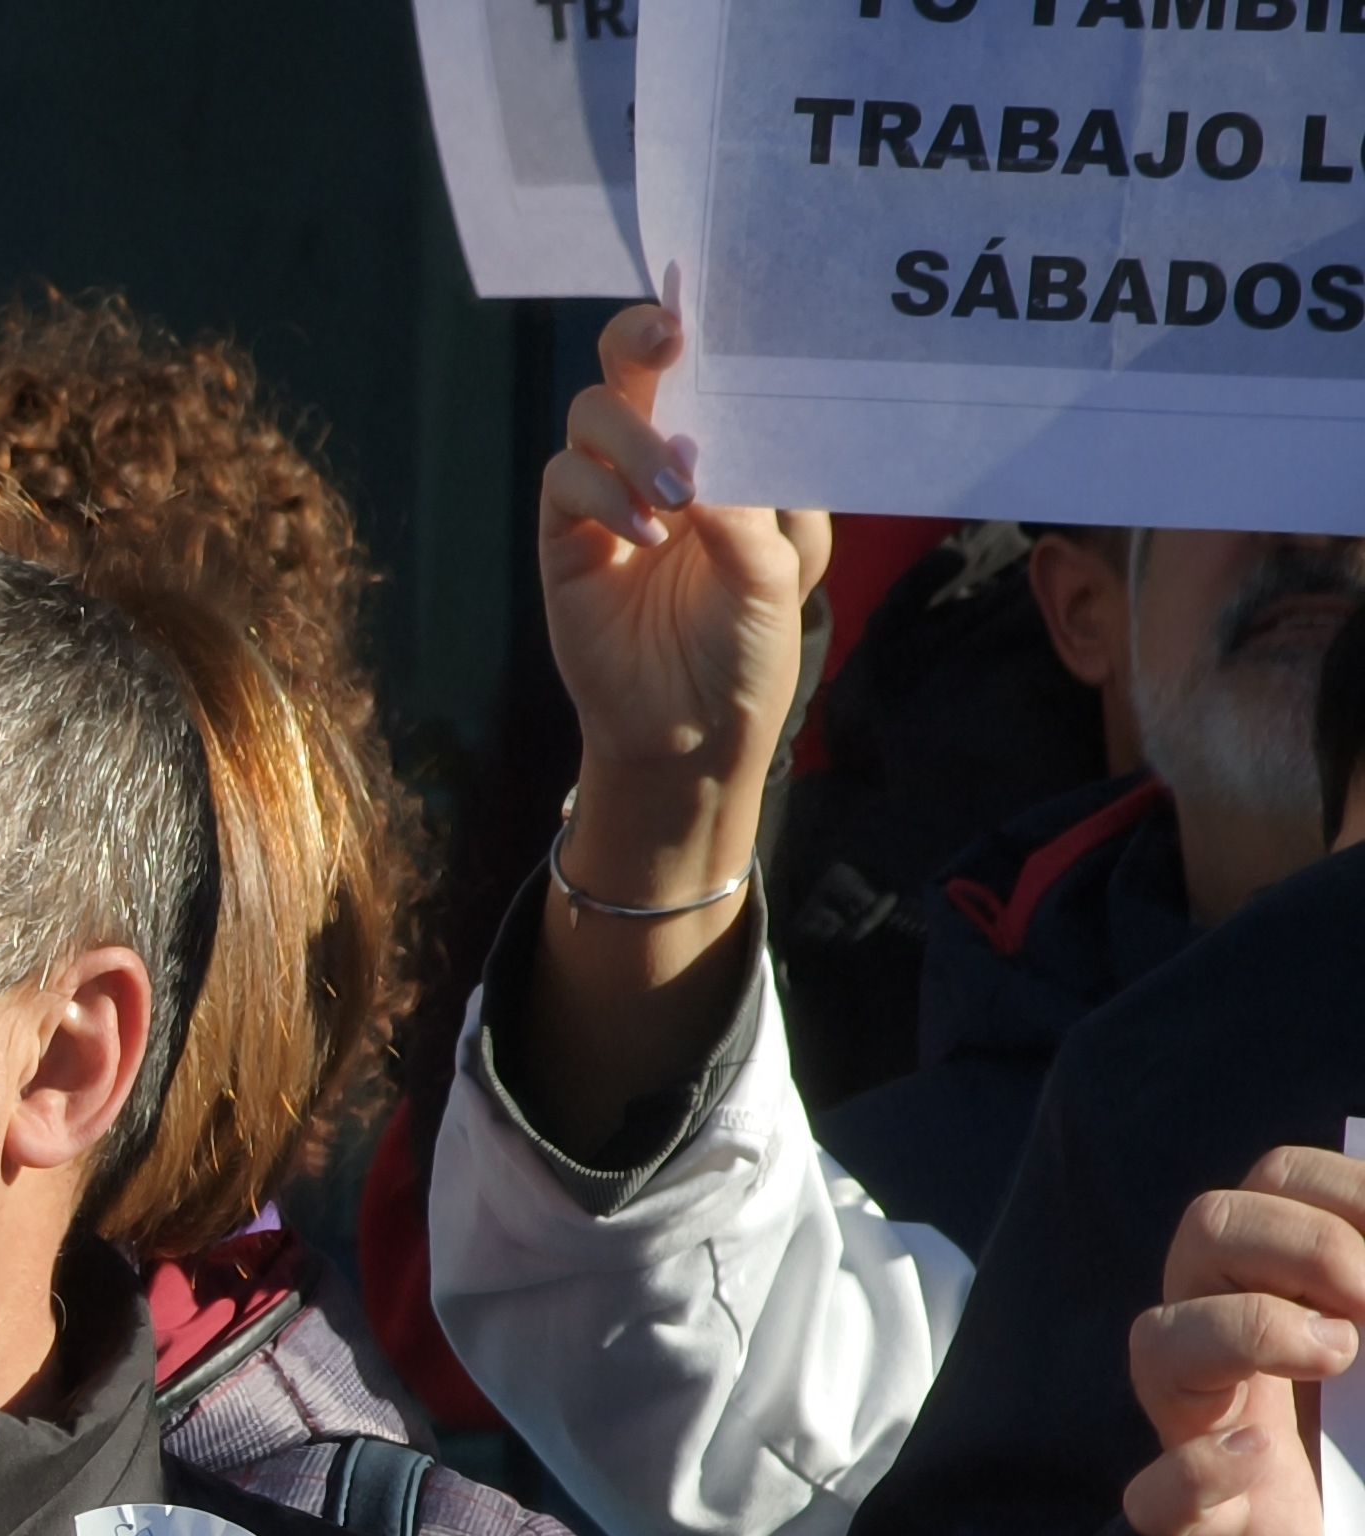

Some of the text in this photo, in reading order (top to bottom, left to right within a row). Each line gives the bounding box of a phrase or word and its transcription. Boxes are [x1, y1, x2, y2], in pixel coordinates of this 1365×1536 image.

[794, 98, 1365, 184] TRABAJO L
[890, 237, 1365, 333] SÁBADOS
